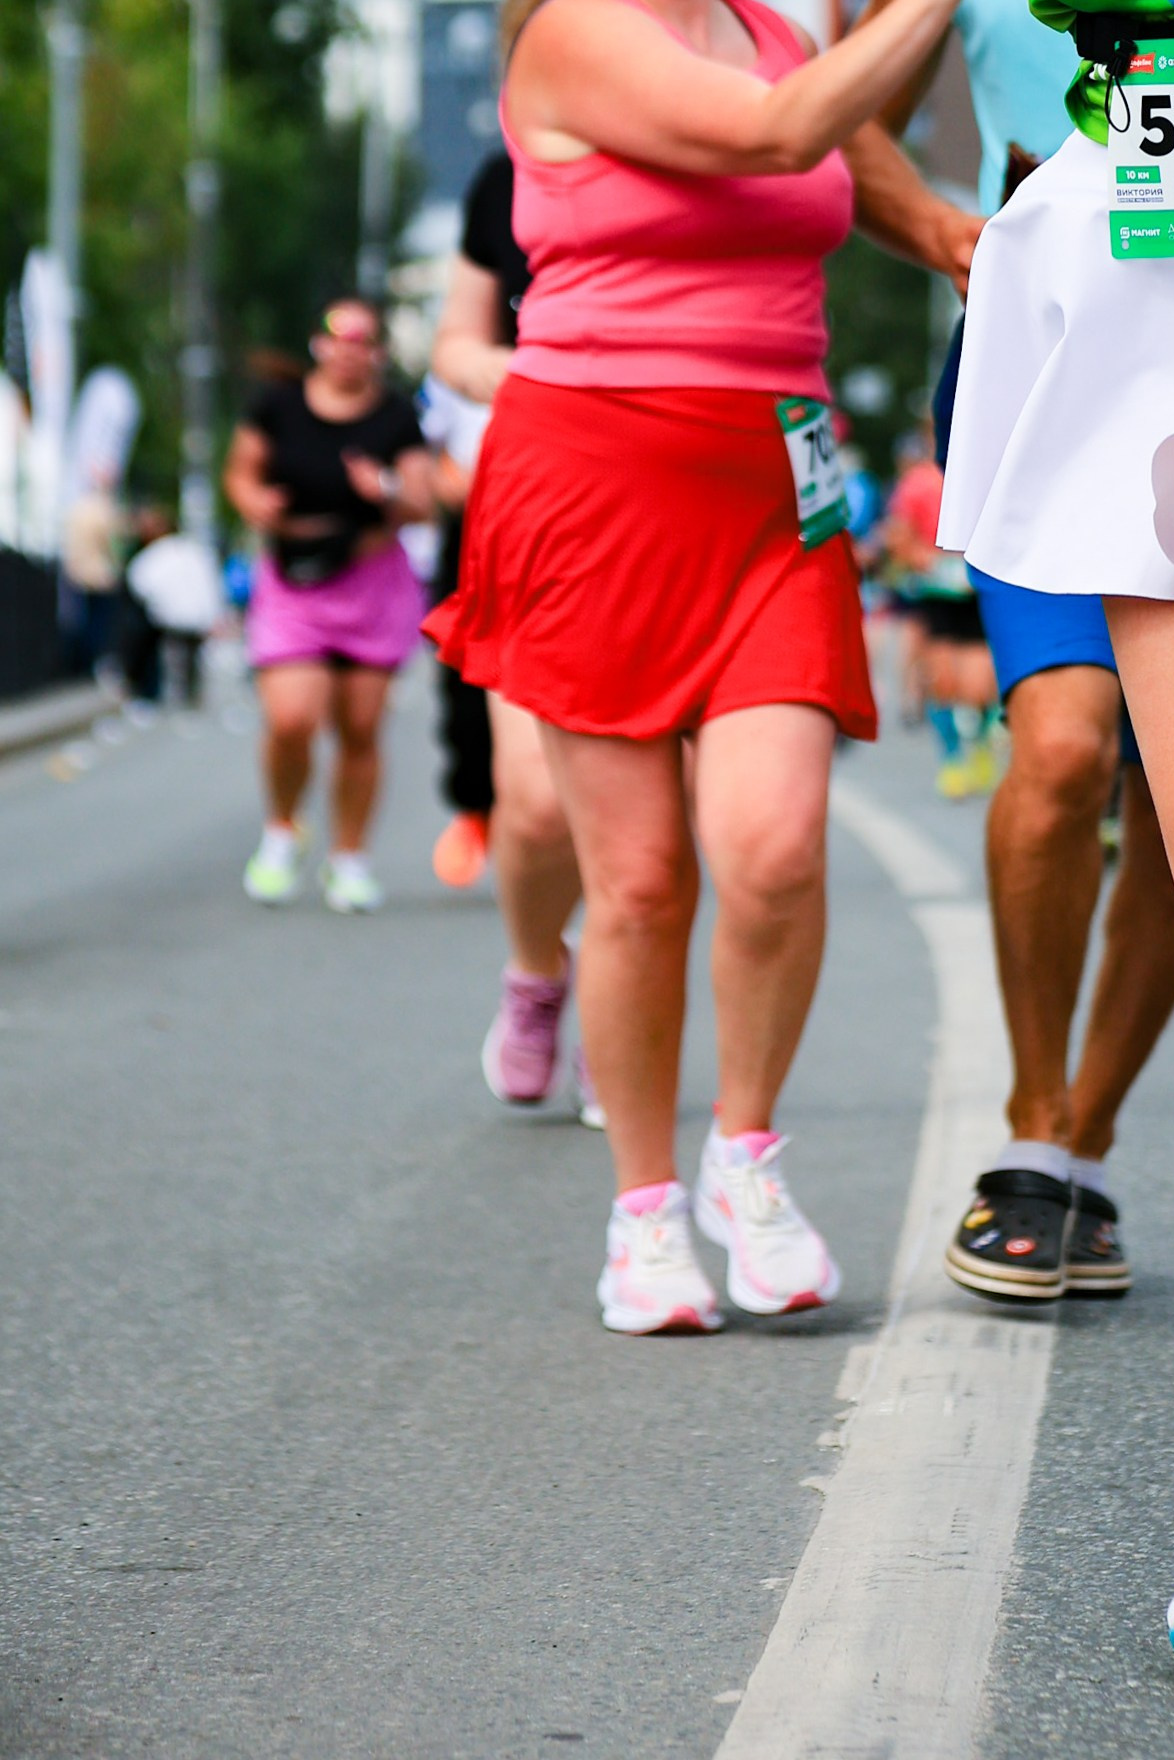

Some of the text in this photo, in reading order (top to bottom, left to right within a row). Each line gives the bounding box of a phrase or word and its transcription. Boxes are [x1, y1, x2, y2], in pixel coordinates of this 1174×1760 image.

[1126, 170, 1137, 180] 10
[1116, 188, 1163, 197] ВИКТОРИЯ
[1131, 228, 1161, 237] МАГНИТ
